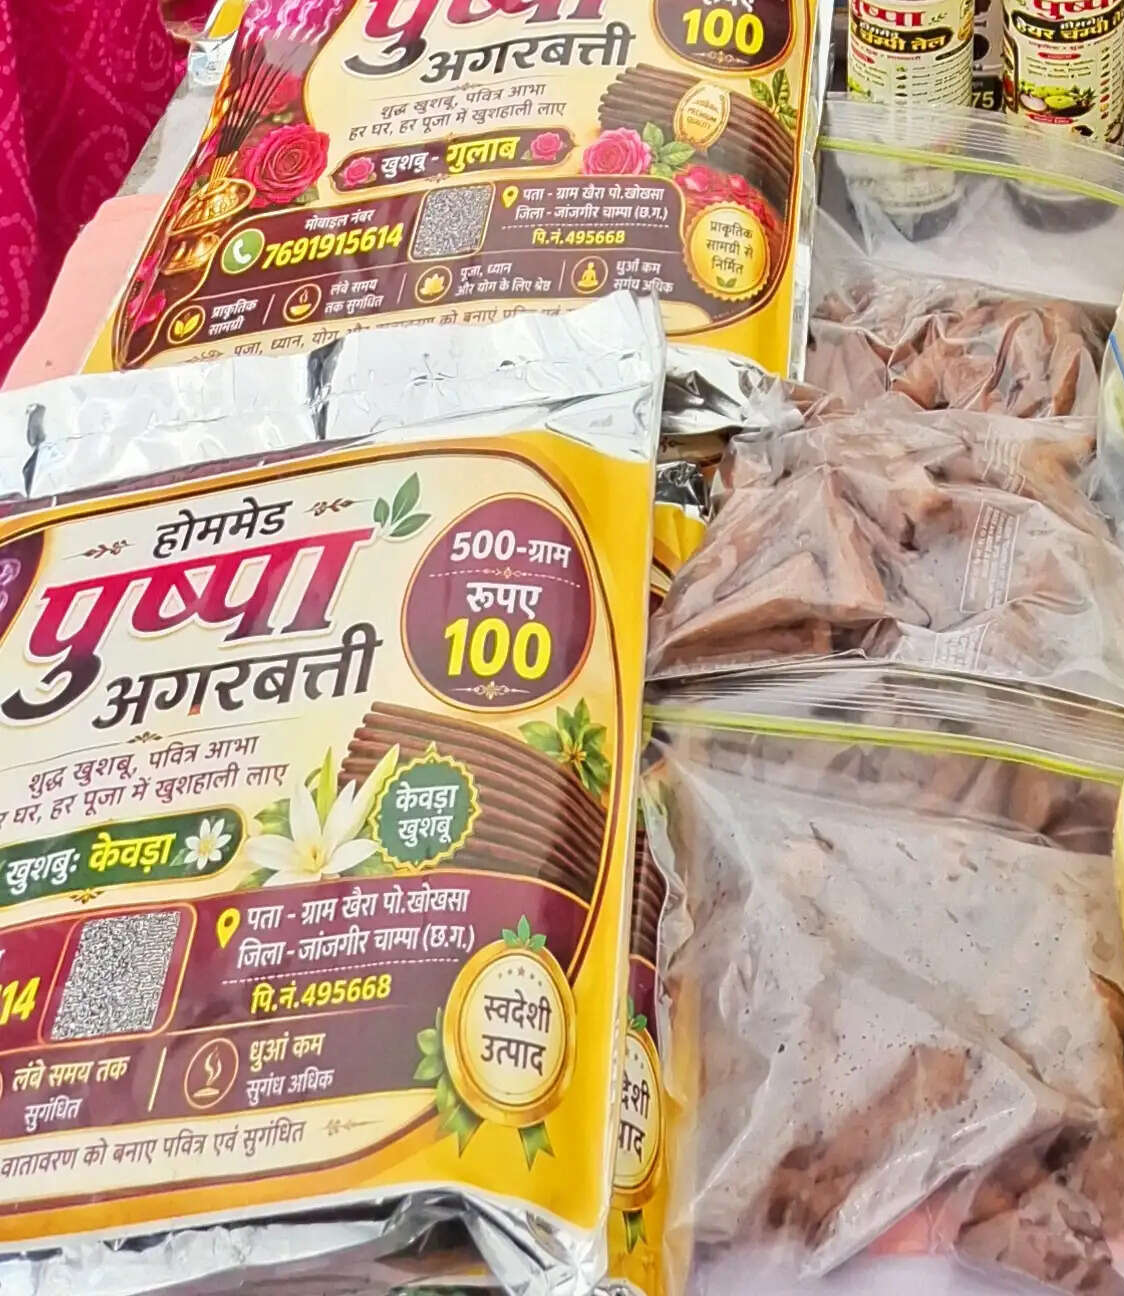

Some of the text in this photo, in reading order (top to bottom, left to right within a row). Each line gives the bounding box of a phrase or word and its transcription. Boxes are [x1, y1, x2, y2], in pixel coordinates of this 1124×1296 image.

[682, 8, 765, 57] 100
[421, 26, 637, 85] अगरबत्ती
[466, 89, 502, 104] पवित्र
[507, 82, 547, 98] आभा
[348, 100, 568, 141] हर घर, हर पूजा में खुशहाली लाए
[446, 136, 521, 174] गुलाब
[514, 205, 546, 222] जिला
[553, 204, 600, 221] जांजगीर
[602, 205, 632, 220] चाम्पा
[523, 188, 545, 202] पता
[556, 187, 578, 202] ग्राम
[582, 185, 605, 201] खैरा
[304, 212, 348, 232] मोबाइल
[531, 227, 626, 247] पि.नं.495668
[711, 220, 754, 240] प्राकृतिक
[261, 222, 406, 271] 7691915614
[706, 238, 742, 257] सामग्री
[711, 256, 745, 276] निर्मित
[351, 277, 379, 292] समय
[455, 277, 533, 297] और योग लिए
[460, 261, 512, 281] पूजा, ध्यान
[644, 261, 661, 275] कम
[209, 318, 245, 337] सामग्री
[211, 297, 259, 321] प्राकृतिक
[324, 301, 346, 314] तक
[151, 495, 294, 560] होममेड
[449, 528, 574, 570] 500-ग्राम
[464, 579, 545, 622] रूपए
[2, 525, 376, 727] पुष्पा
[441, 616, 552, 683] 100
[92, 621, 384, 729] अगरबत्ती
[28, 735, 260, 800] शुद्ध खुशबू, पवित्र आभा
[12, 803, 42, 825] घर,
[50, 794, 77, 821] हर
[83, 786, 126, 815] पूजा
[131, 777, 152, 801] में
[154, 762, 240, 804] खुशहाली
[246, 762, 290, 788] लाए
[395, 780, 460, 816] केवड़ा
[397, 813, 454, 850] खुशबू
[89, 830, 178, 874] केवड़ा
[247, 883, 471, 930] पता ग्राम खैरा पो.खोखसा
[237, 922, 476, 970] जिला जांजगीर चाम्पा (छ.ग.)
[251, 973, 392, 1014] पि.नं.495668
[483, 988, 554, 1035] स्वदेशी
[250, 1032, 326, 1072] धुआं कम
[480, 1034, 547, 1078] उत्पाद
[12, 1056, 131, 1092] लंबे समय तक
[246, 1065, 335, 1106] सुगंध अधिक
[24, 1095, 83, 1133] सुगंधित
[0, 1116, 307, 1179] वातावरण को बनाए पवित्र एवं सुगंधित
